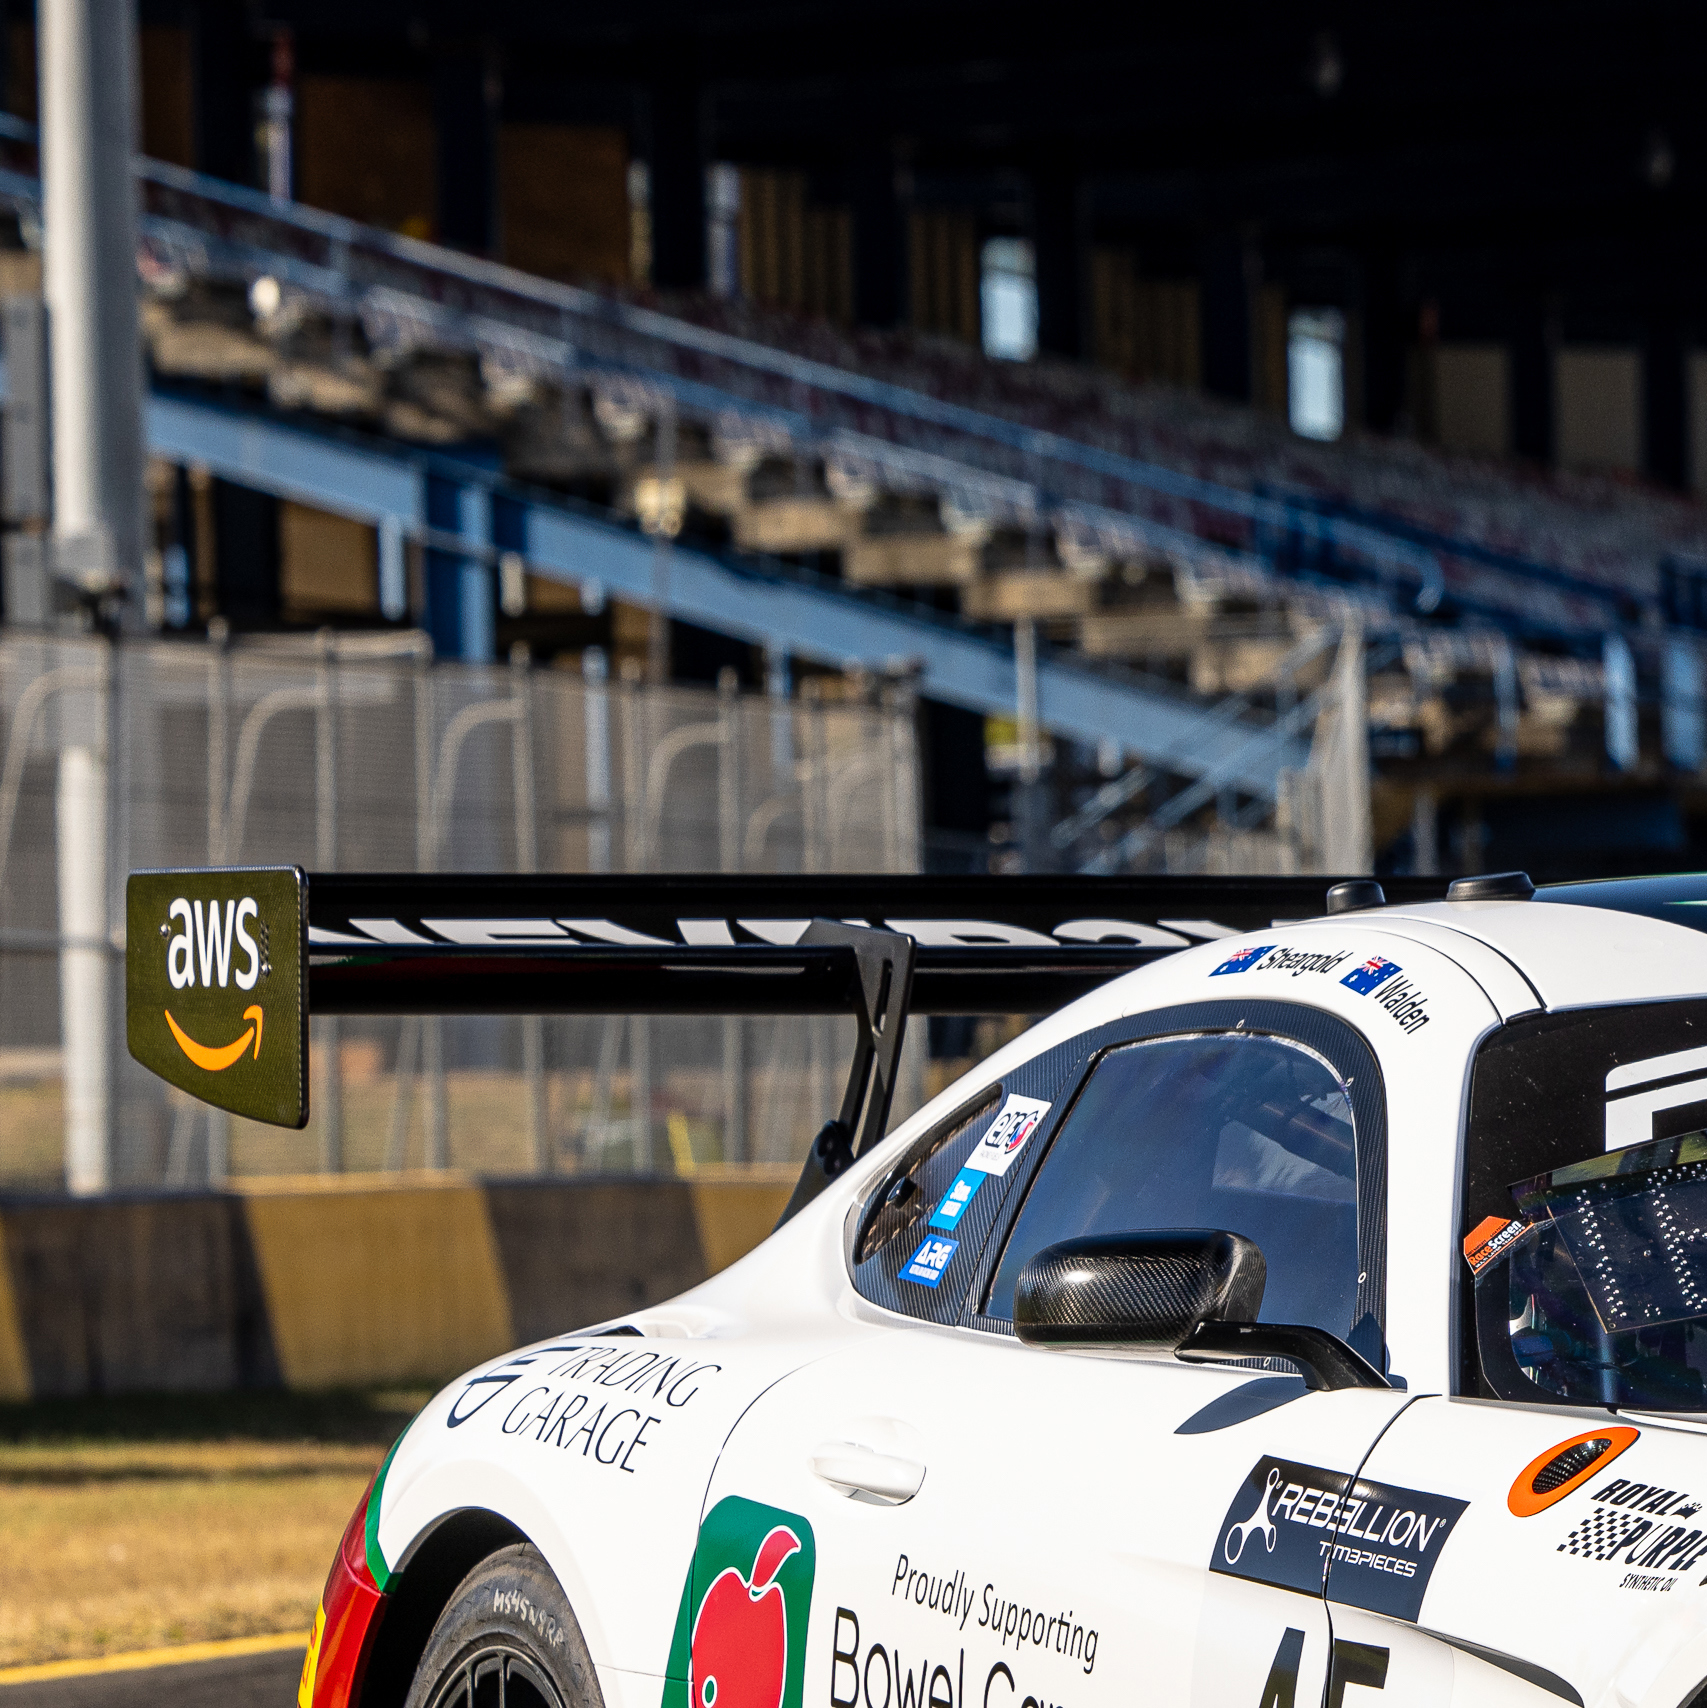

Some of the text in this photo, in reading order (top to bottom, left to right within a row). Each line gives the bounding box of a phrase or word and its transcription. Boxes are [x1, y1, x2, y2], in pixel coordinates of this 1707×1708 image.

[167, 897, 260, 990] aws
[1257, 947, 1354, 977] Sheargold
[1374, 975, 1430, 1035] Walden
[914, 1240, 953, 1270] ARG
[1468, 1220, 1523, 1266] RaceScreen
[548, 1346, 722, 1407] TRADING
[502, 1387, 662, 1474] GARAGE
[1590, 1478, 1690, 1516] ROYAL
[1619, 1573, 1679, 1592] SYNTHETIC OIL
[892, 1554, 1099, 1674] Proudly Supporting
